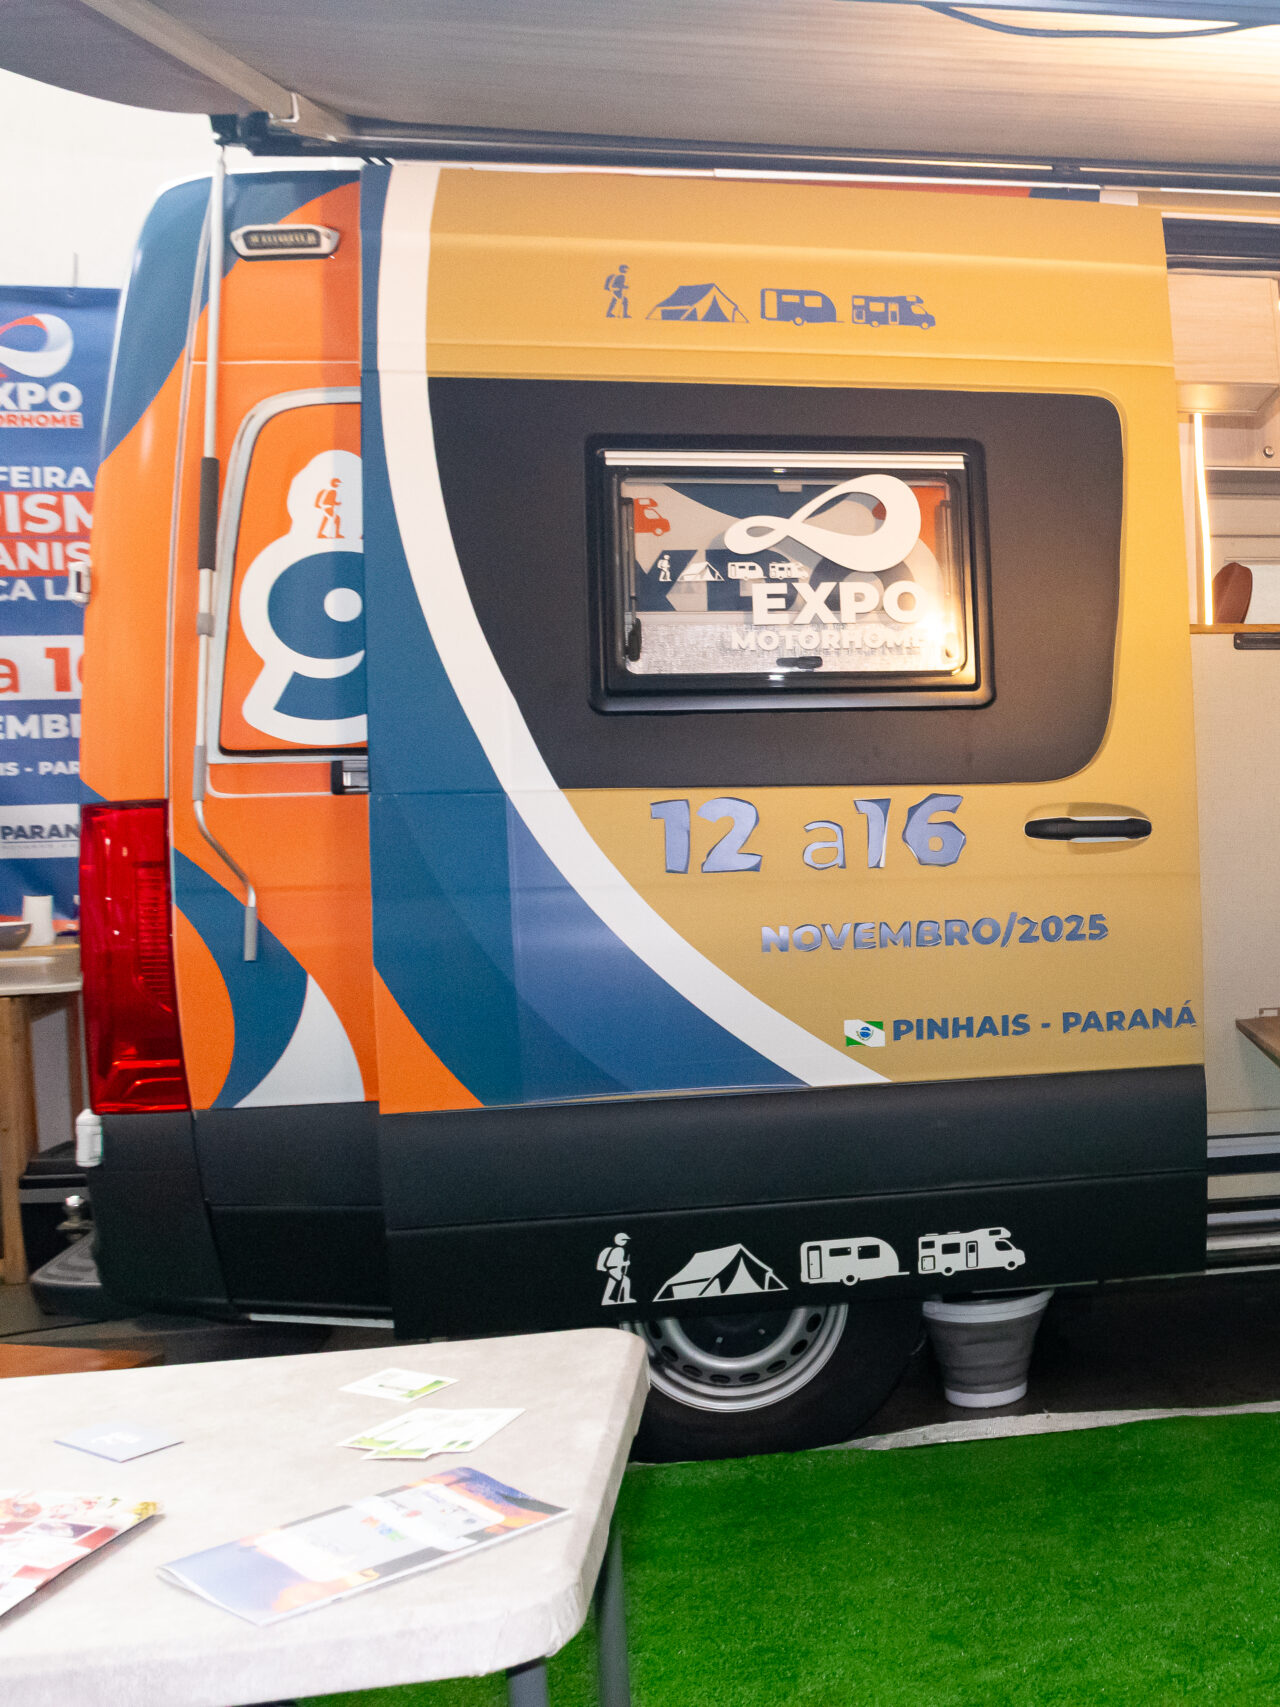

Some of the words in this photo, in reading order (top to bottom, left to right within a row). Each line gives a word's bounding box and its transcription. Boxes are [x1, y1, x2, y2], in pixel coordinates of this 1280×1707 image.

[752, 580, 929, 626] EXPO
[45, 647, 84, 692] 1
[650, 797, 763, 874] 12
[760, 911, 1109, 953] NOVEMBRO/2025
[892, 1013, 1031, 1042] PINHAIS
[1062, 1000, 1198, 1034] PARANÁ
